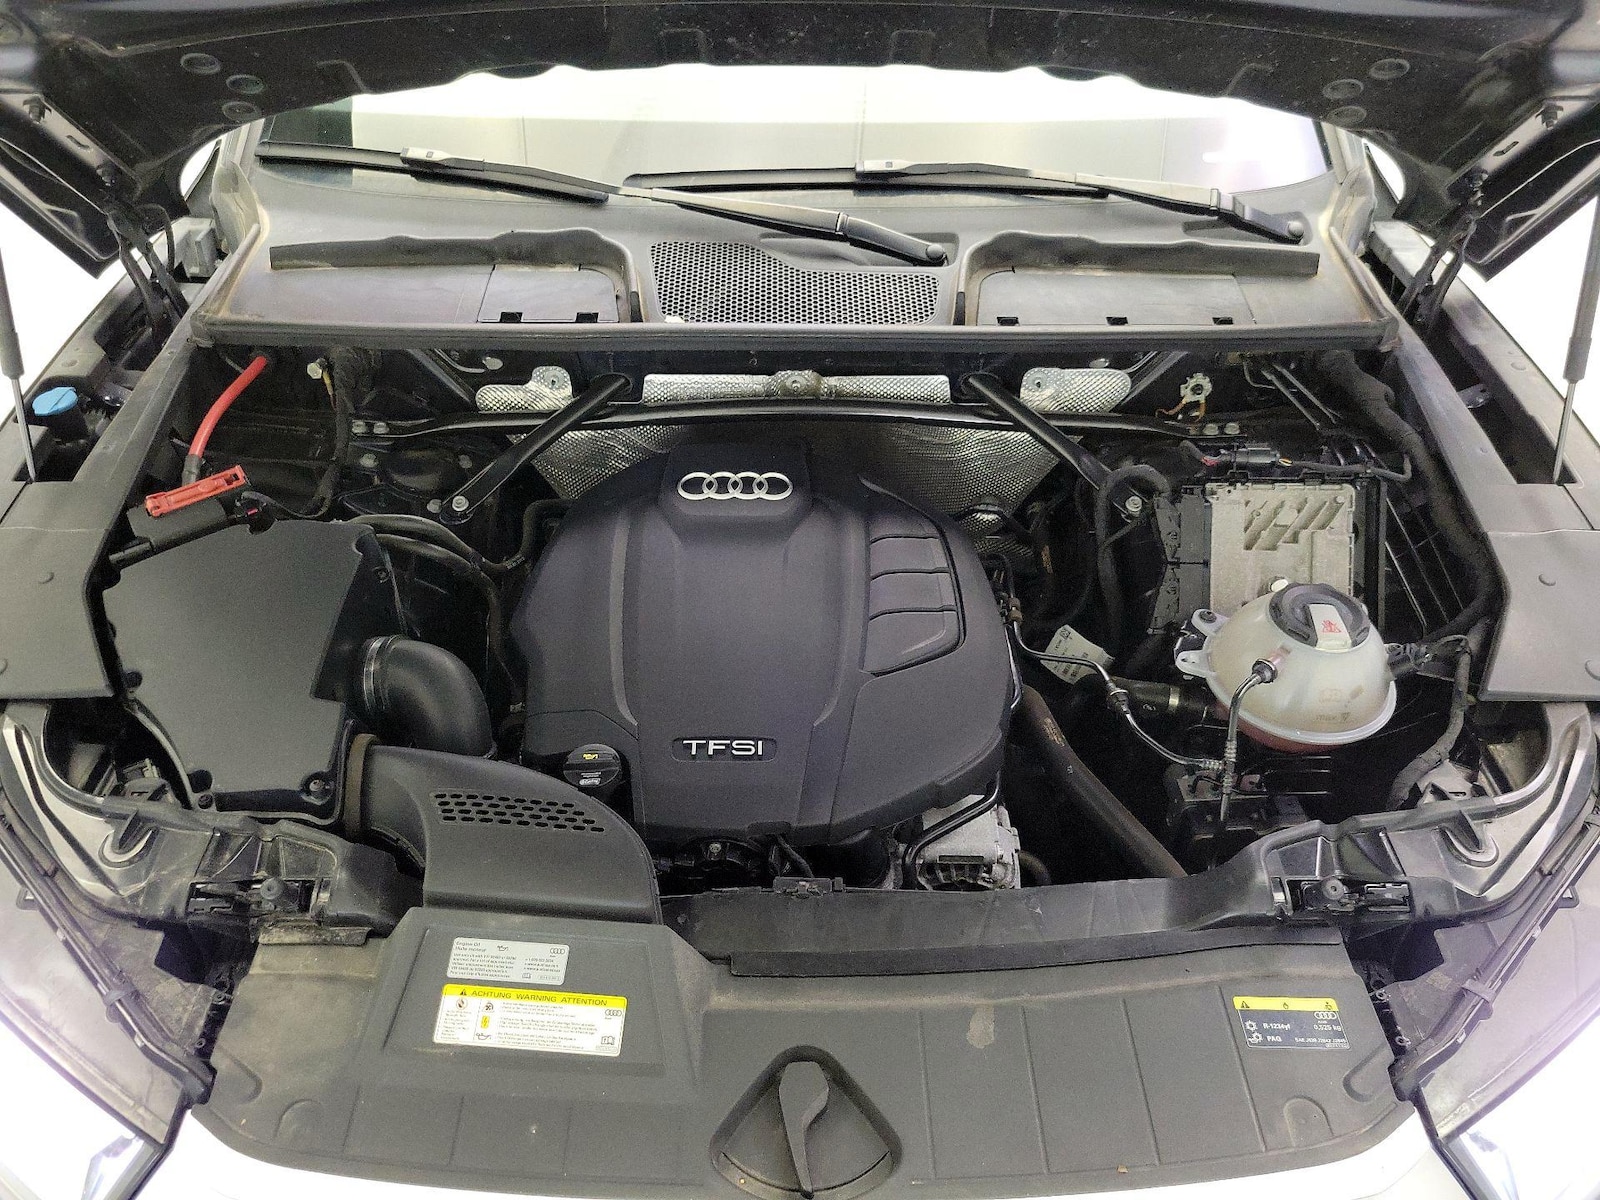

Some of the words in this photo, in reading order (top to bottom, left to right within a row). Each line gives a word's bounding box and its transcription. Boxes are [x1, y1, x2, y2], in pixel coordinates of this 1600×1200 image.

[682, 740, 763, 756] TFSI
[471, 990, 512, 1000] ACHTUNG
[516, 994, 557, 1003] WARNING
[561, 997, 608, 1006] ATTENTION
[1331, 1024, 1342, 1032] kg
